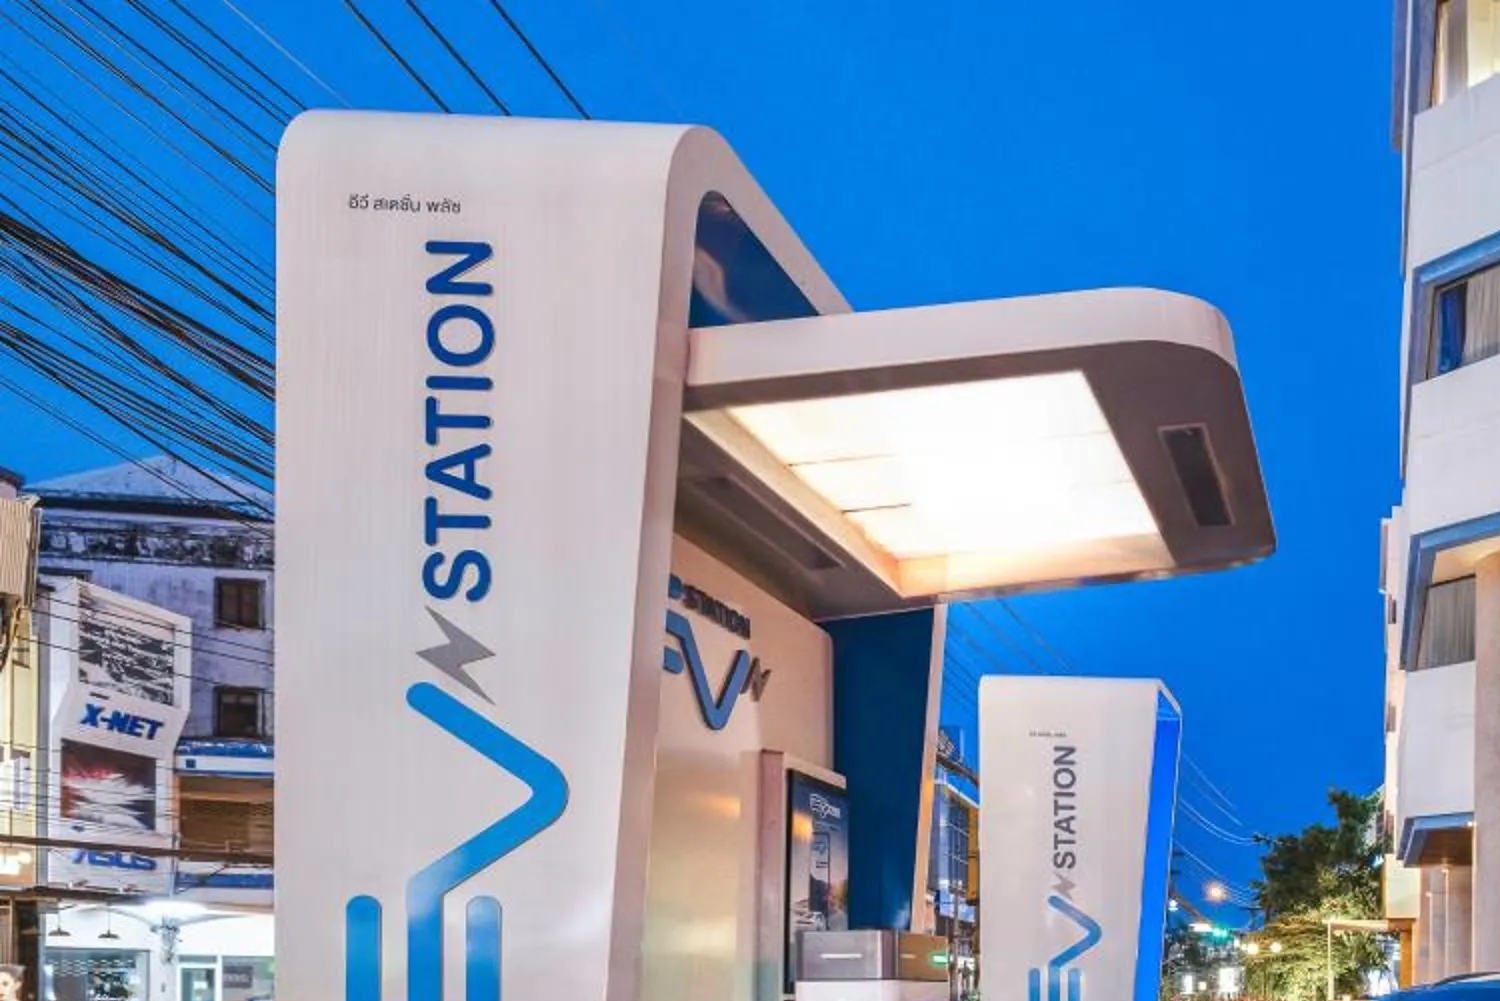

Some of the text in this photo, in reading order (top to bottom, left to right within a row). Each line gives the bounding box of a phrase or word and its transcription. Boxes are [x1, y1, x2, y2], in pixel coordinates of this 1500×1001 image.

[422, 240, 496, 602] STATION
[80, 703, 164, 740] X-NET
[1053, 745, 1078, 870] STATION
